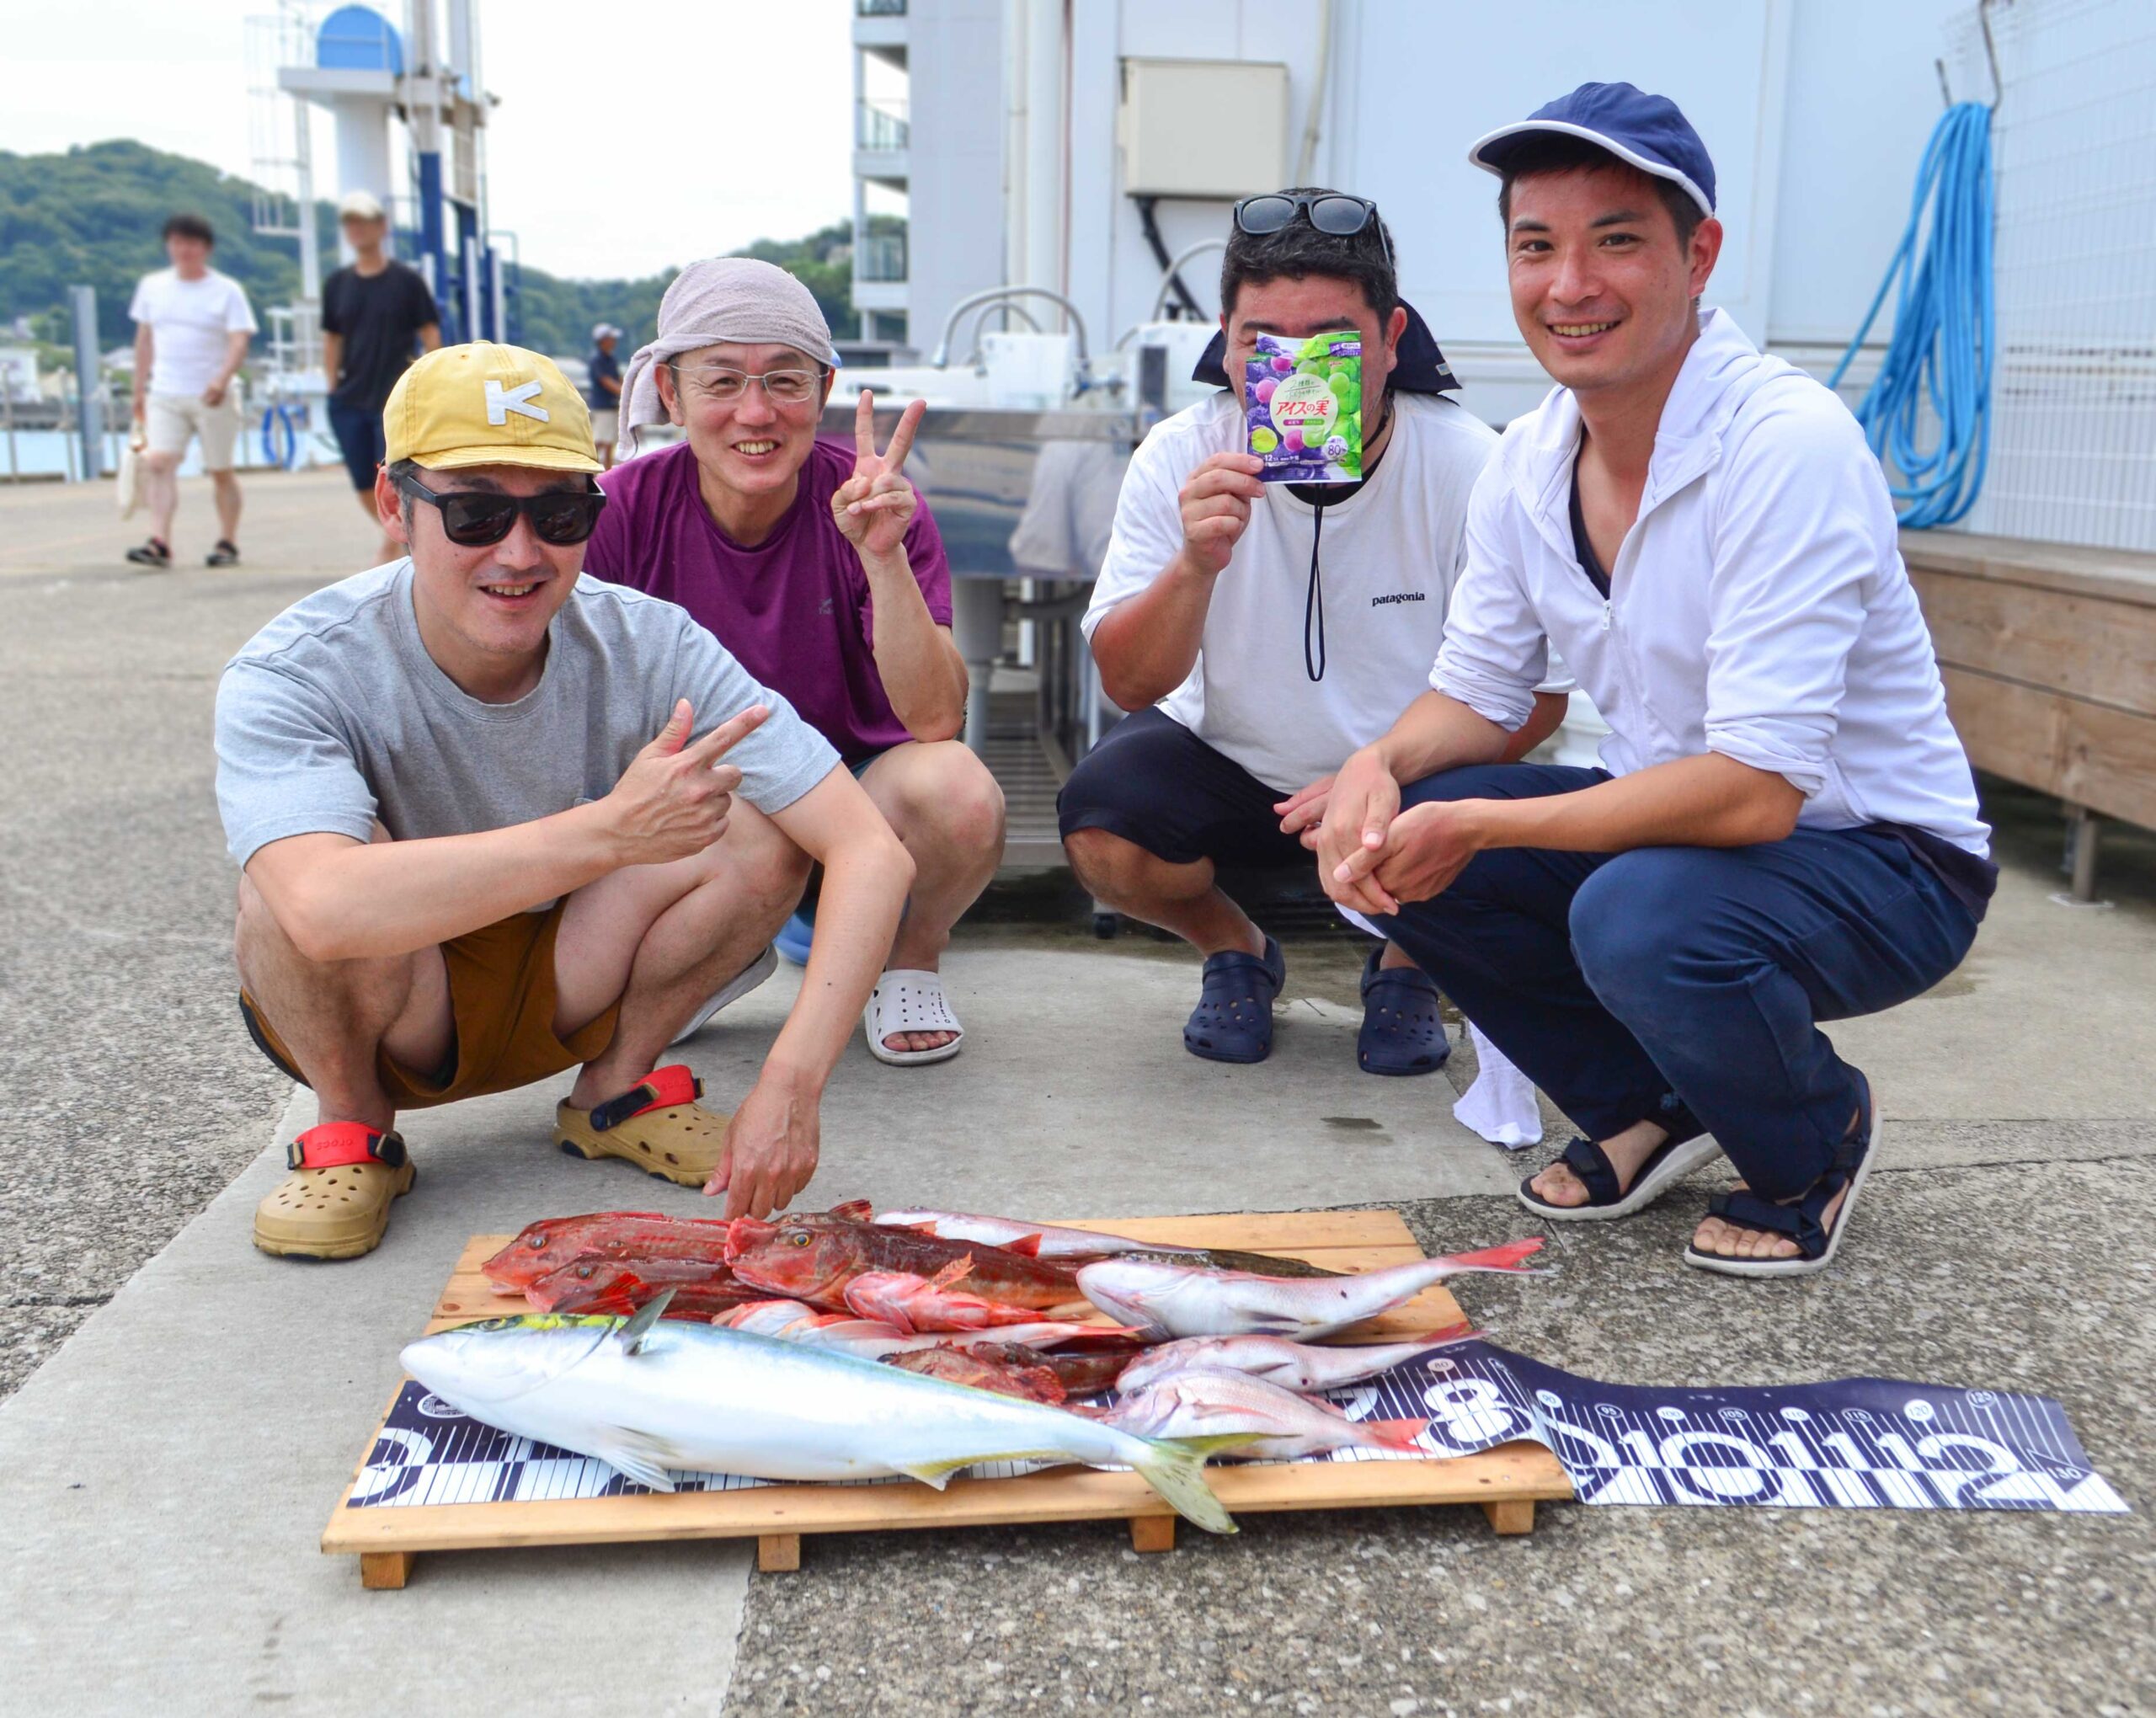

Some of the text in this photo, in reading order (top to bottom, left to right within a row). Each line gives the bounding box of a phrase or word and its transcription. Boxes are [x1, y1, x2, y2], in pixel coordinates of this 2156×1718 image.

[483, 379, 550, 425] K
[1275, 398, 1330, 416] アイスの実
[1372, 591, 1425, 606] patagonia
[317, 1138, 354, 1150] crocs
[1971, 1390, 1992, 1406] 125
[1423, 1377, 1533, 1451] 8
[1721, 1411, 1742, 1420] 105
[1784, 1410, 1805, 1420] 110
[1847, 1411, 1867, 1421] 115
[1908, 1405, 1929, 1417] 120
[1617, 1429, 1784, 1506] 10
[1767, 1430, 1897, 1507] 11
[1875, 1432, 2055, 1510] 12
[2049, 1467, 2082, 1480] 130
